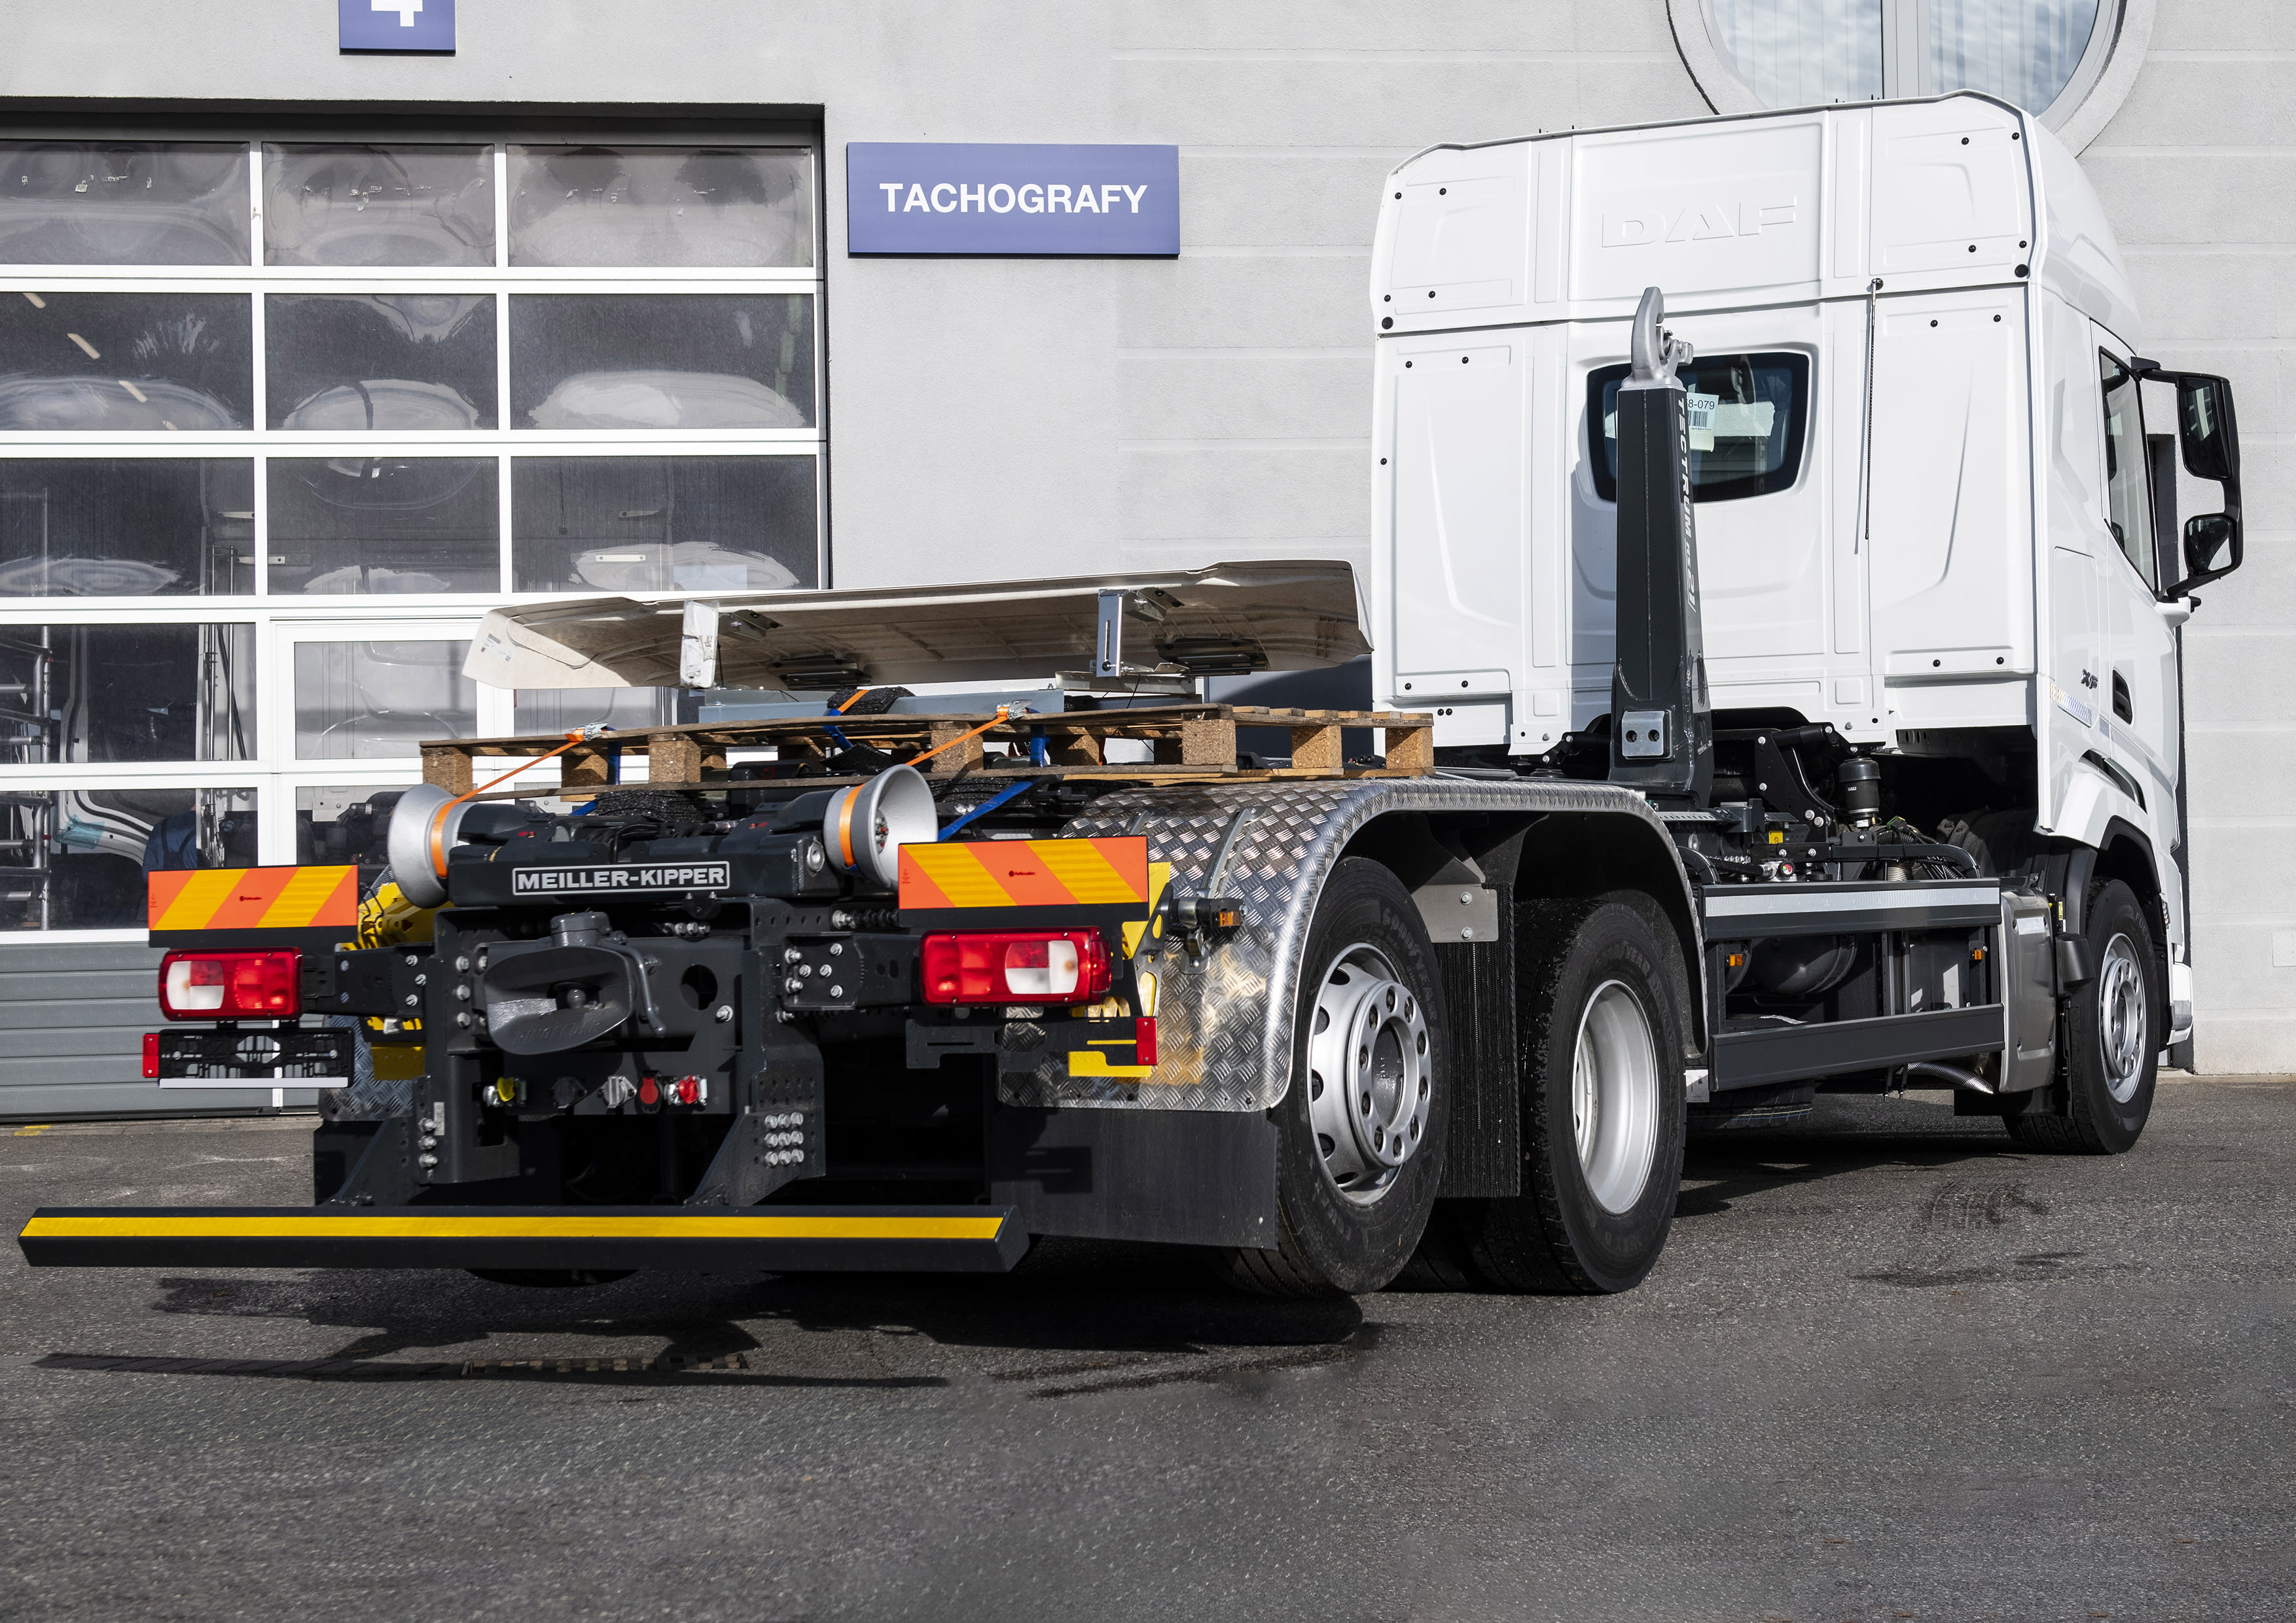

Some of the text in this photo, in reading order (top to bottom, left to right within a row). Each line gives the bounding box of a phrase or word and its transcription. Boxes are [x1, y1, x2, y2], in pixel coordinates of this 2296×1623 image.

[879, 183, 1147, 213] TACHOGRAFY
[1602, 196, 1797, 248] DAF
[1687, 399, 1715, 410] 8-079
[1677, 397, 1693, 538] TECTRUM
[2080, 668, 2099, 690] XF
[518, 868, 725, 889] MEILLER-KIPPER
